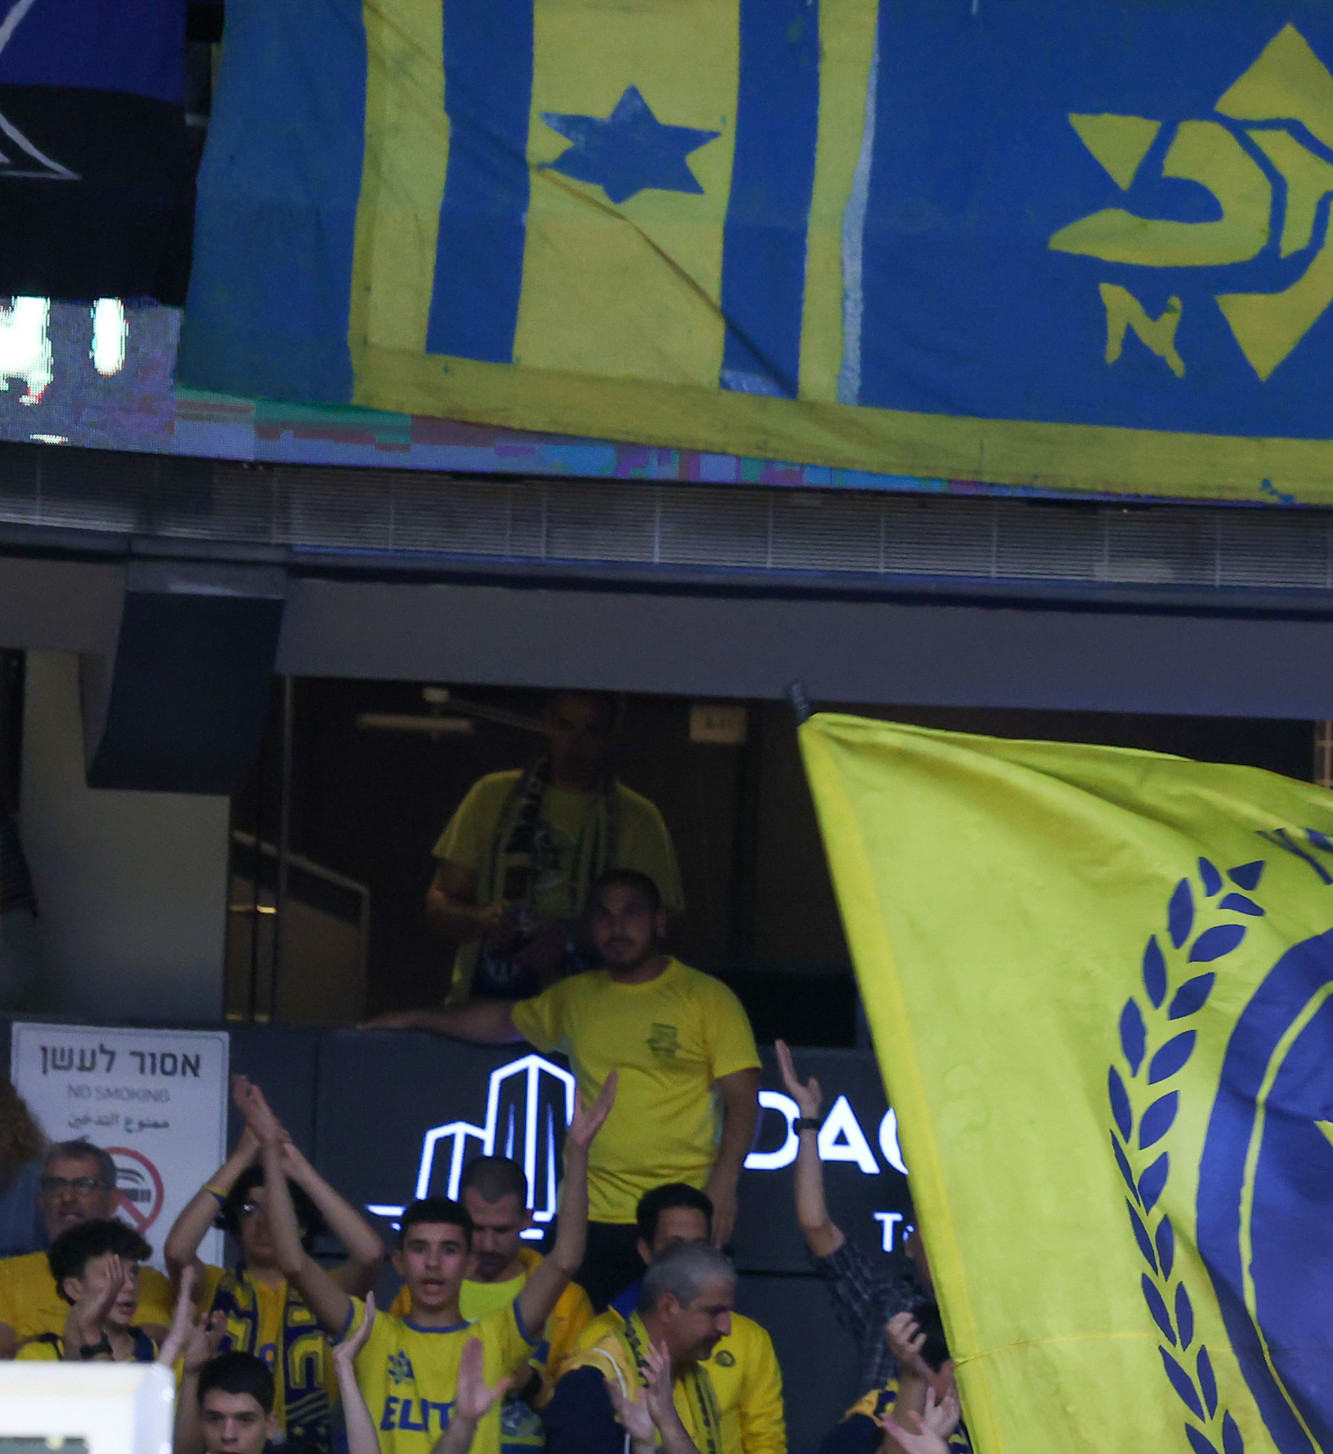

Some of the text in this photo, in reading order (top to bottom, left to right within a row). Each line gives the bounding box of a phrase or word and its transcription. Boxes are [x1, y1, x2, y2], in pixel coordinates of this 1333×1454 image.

[40, 1043, 200, 1077] אסור לעשן
[67, 1083, 171, 1103] NO SMOKING
